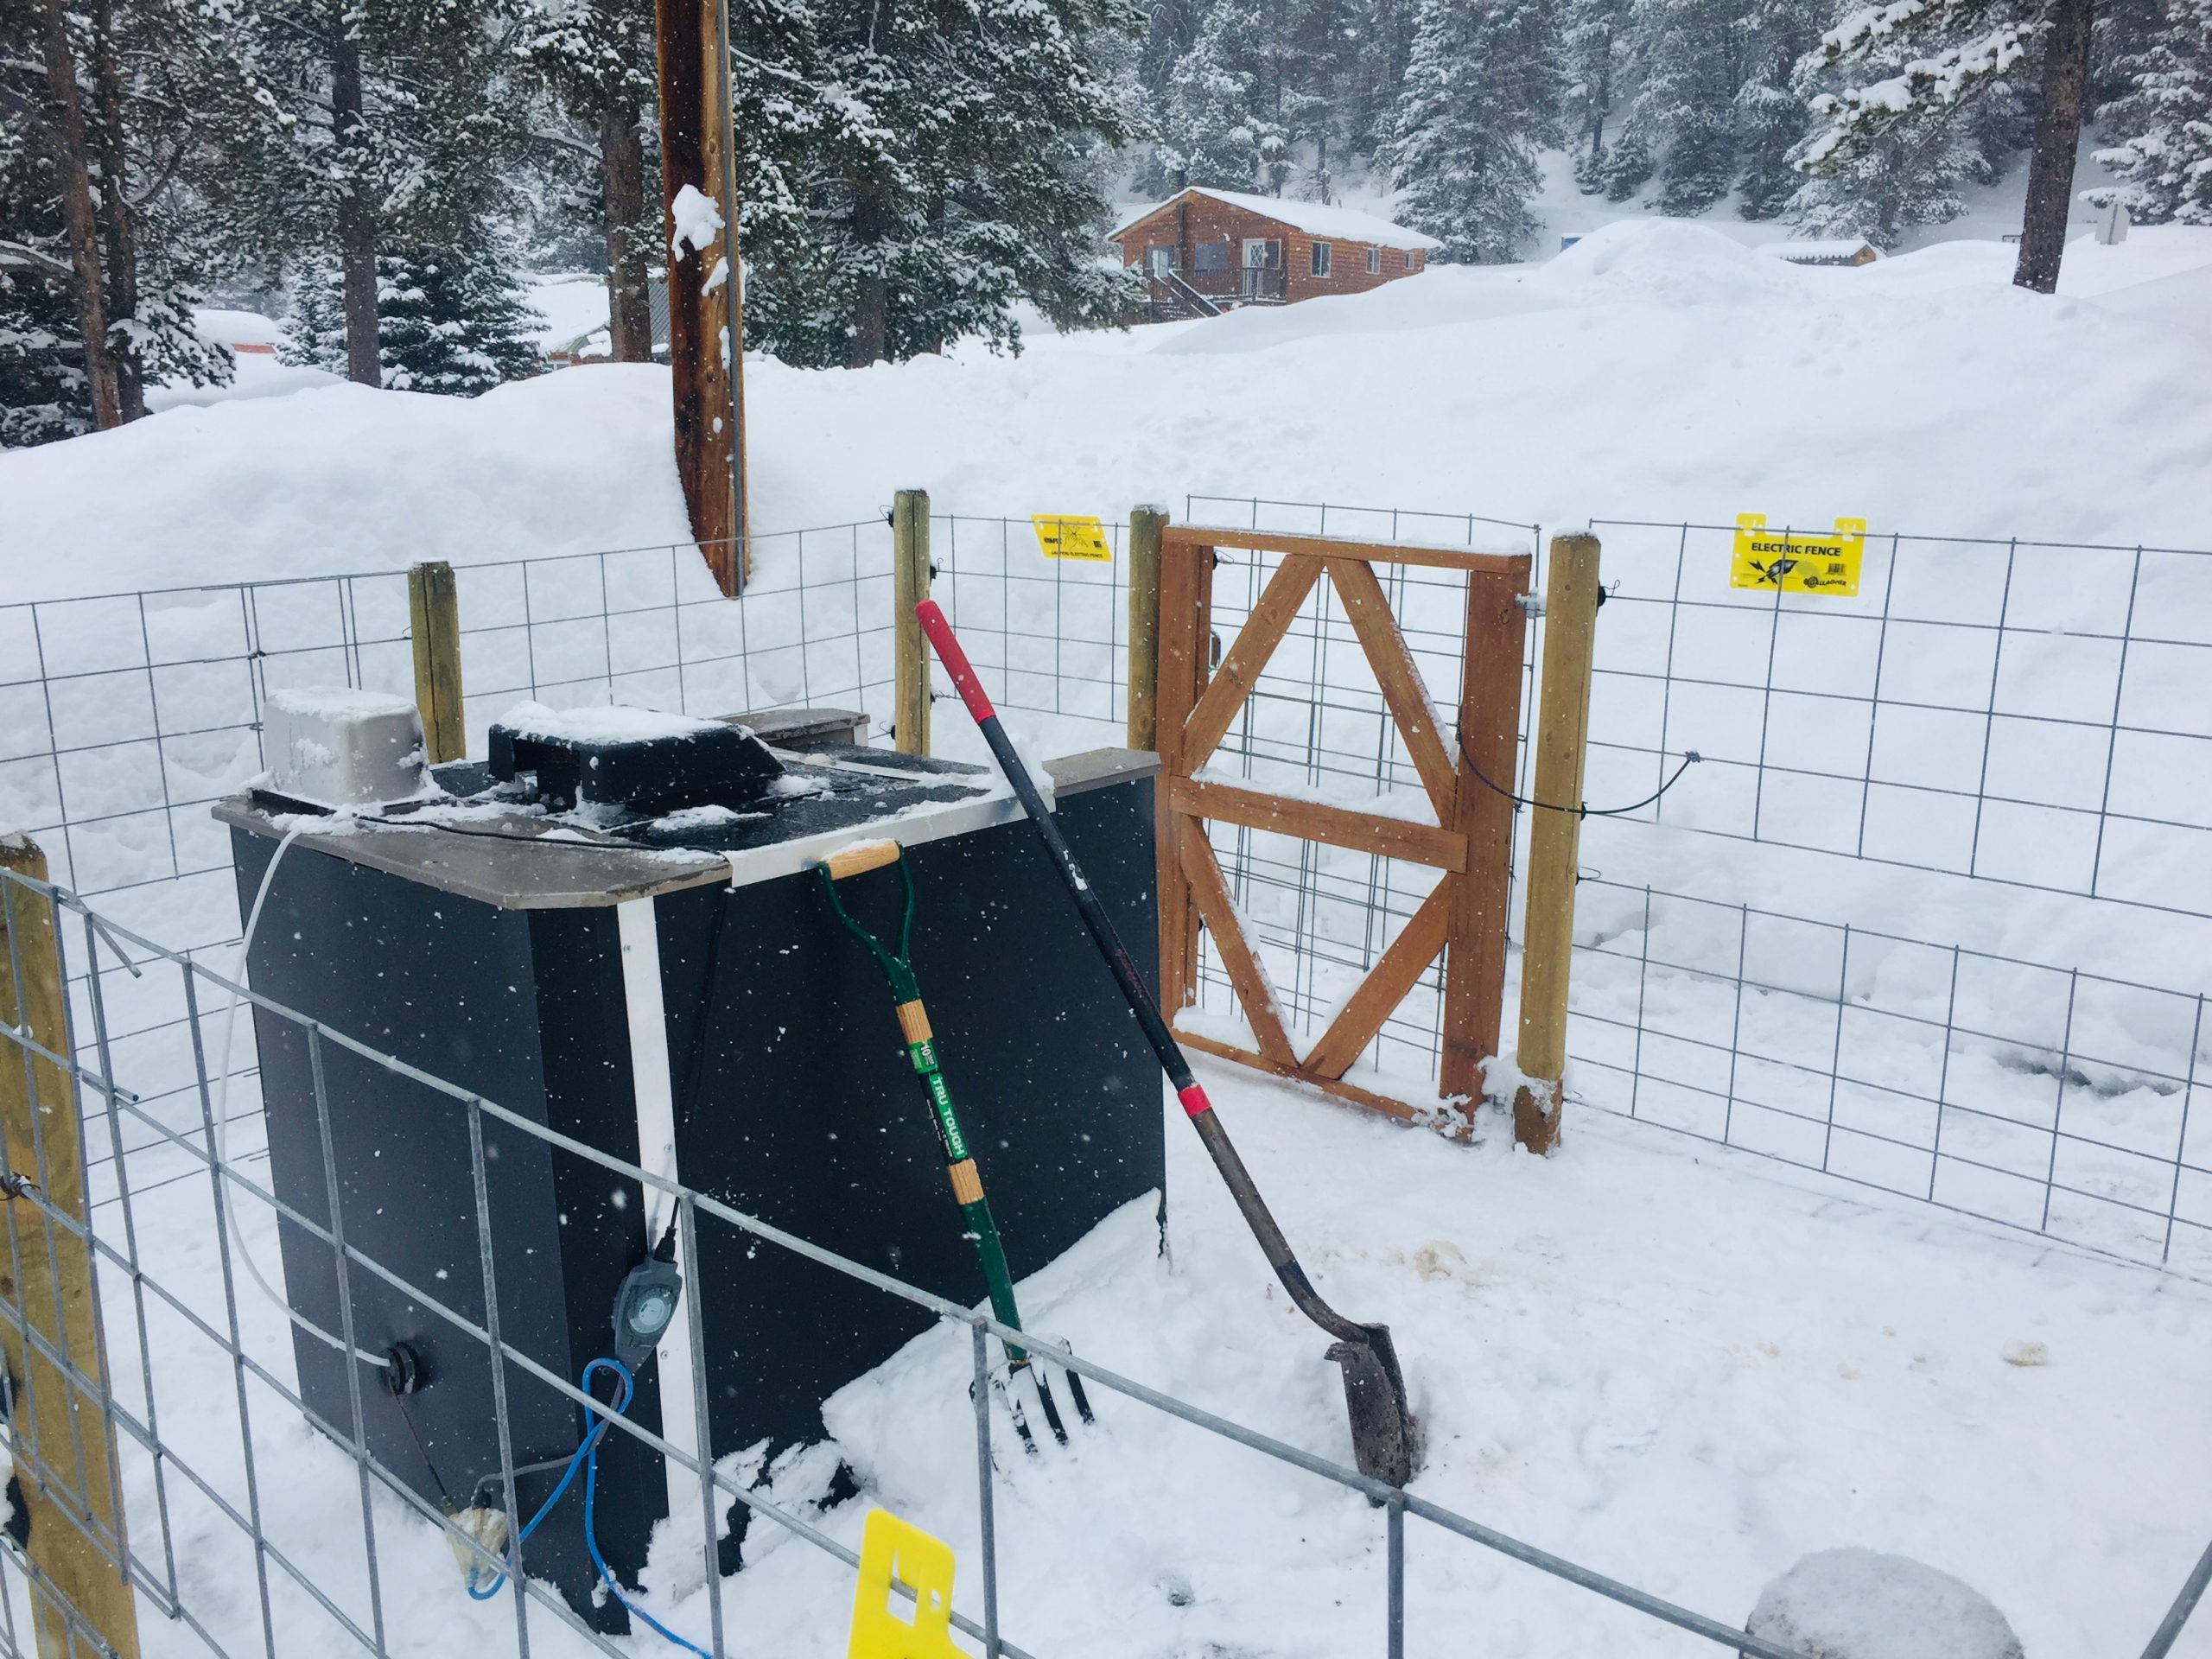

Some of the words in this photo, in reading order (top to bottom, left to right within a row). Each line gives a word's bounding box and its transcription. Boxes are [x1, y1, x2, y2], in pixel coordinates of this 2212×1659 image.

[1751, 543, 1802, 554] ELECTRIC
[1805, 546, 1841, 556] FENCE
[1805, 576, 1847, 588] GALLAGHER
[920, 1043, 931, 1056] 10
[933, 1076, 949, 1106] TRU
[943, 1107, 965, 1156] TOUGH
